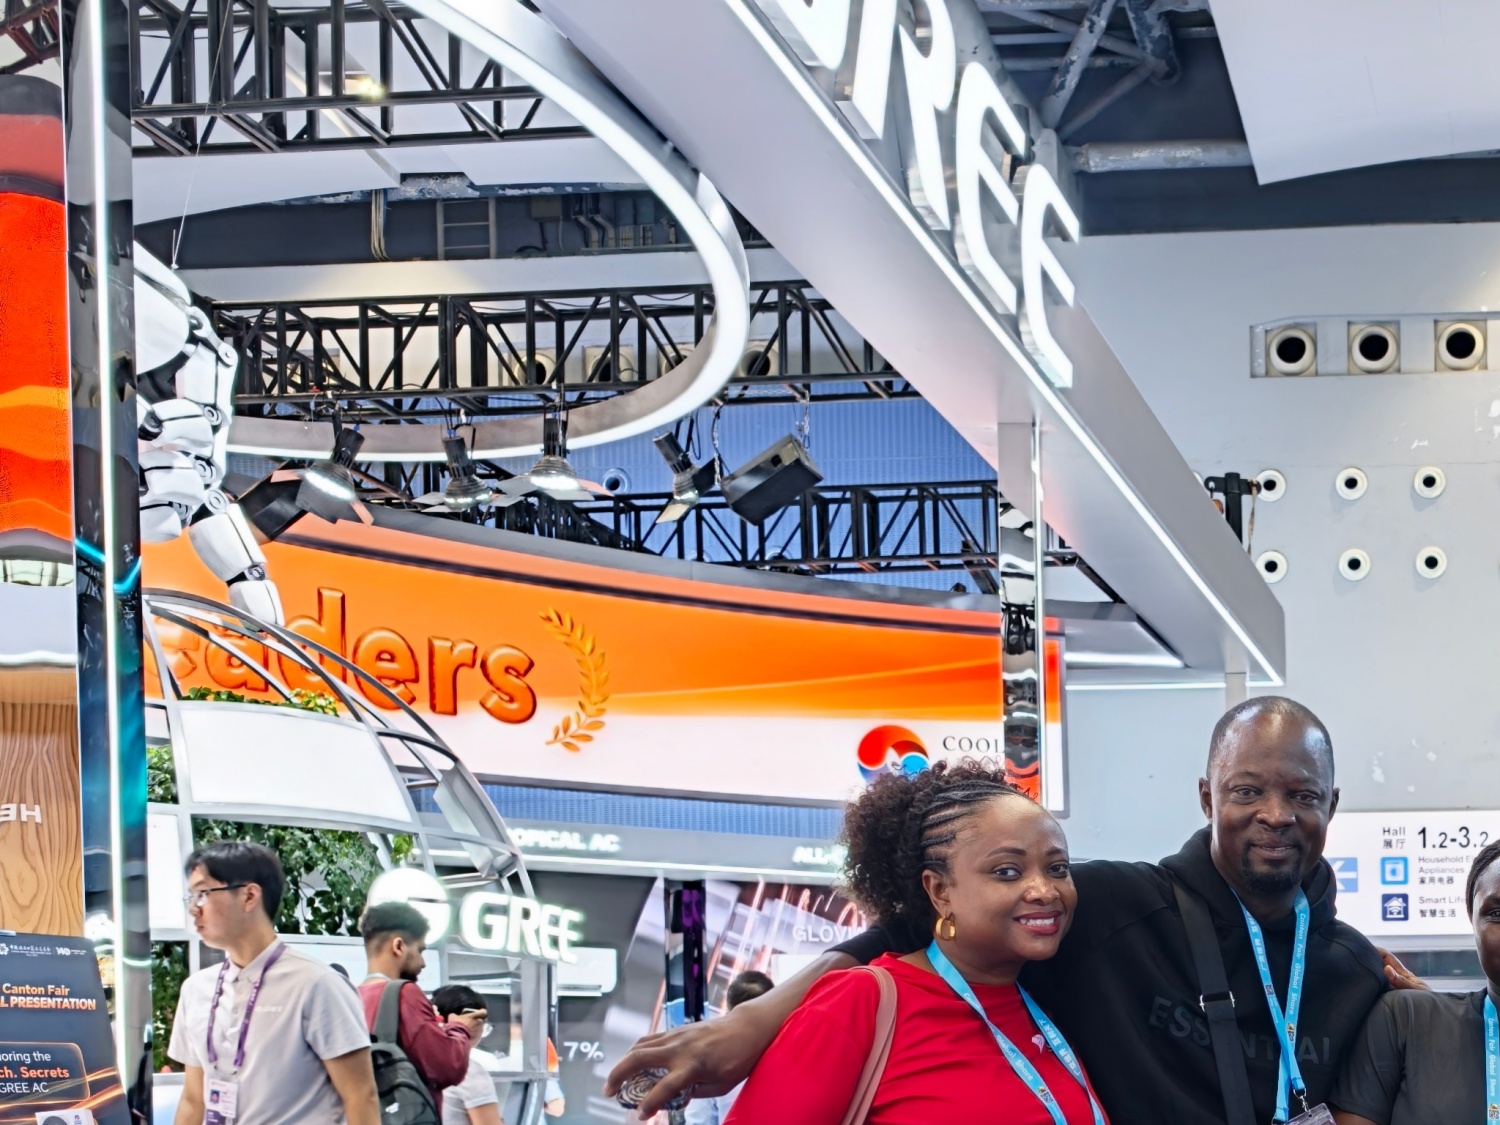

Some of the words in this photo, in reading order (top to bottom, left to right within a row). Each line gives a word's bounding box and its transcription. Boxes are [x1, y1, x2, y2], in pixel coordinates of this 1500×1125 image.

[1382, 827, 1406, 836] Hall
[1418, 826, 1489, 849] 1.2-3.2
[1382, 838, 1406, 849] 展厅
[1418, 866, 1465, 875] Appliances
[1418, 876, 1454, 885] 家用电器
[1419, 896, 1446, 904] Smart
[1419, 908, 1457, 918] 智慧生活
[460, 892, 586, 965] GREE
[1292, 963, 1301, 989] Global
[2, 983, 45, 995] Canton
[47, 985, 70, 996] Fair
[10, 996, 97, 1010] PRESENTATION
[1289, 992, 1298, 1015] Share
[32, 1051, 51, 1061] the
[20, 1066, 70, 1078] Secrets
[1015, 1059, 1034, 1081] Share
[32, 1082, 50, 1093] AC
